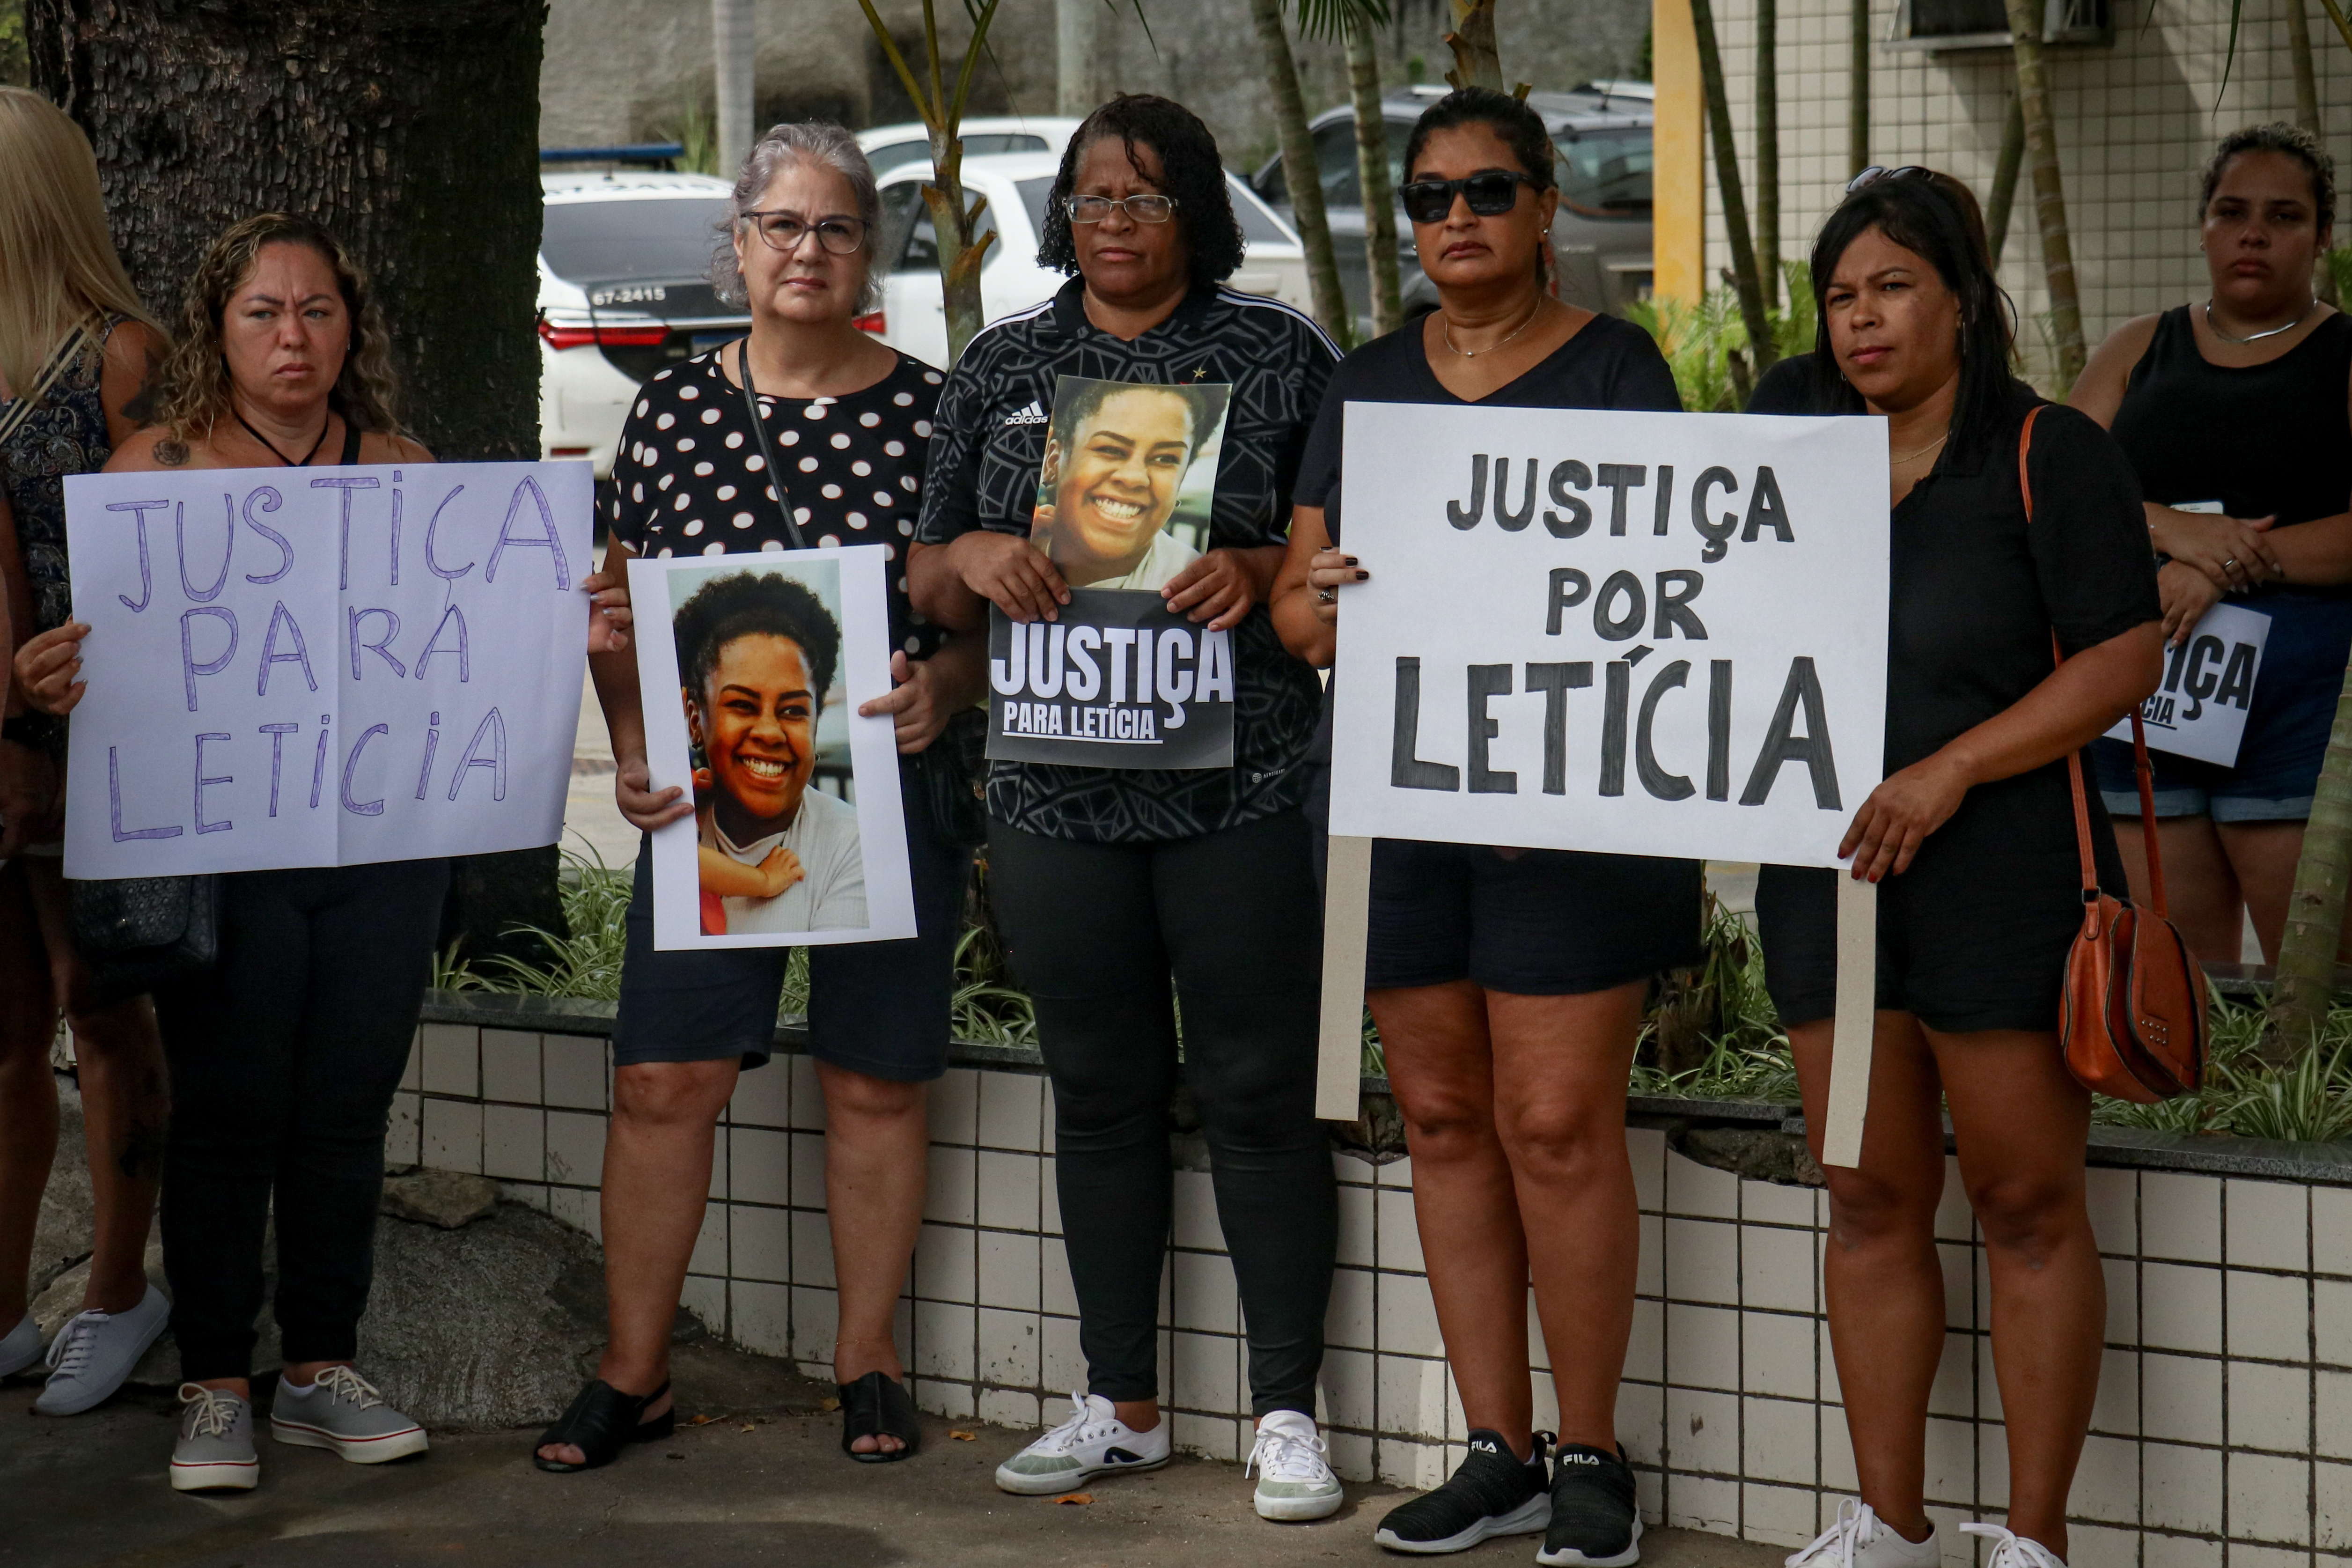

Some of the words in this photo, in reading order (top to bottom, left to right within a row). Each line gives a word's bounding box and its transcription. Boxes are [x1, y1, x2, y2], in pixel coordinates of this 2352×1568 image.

[592, 287, 666, 306] 67-2415
[1005, 415, 1048, 426] adidas
[1446, 453, 1796, 565] JUSTIÇA
[1545, 567, 1709, 641] POR
[180, 600, 469, 712] PARA
[990, 621, 1235, 729] JUSTIÇA
[2167, 634, 2257, 721] IÇA
[1003, 701, 1063, 735] PARA
[1070, 701, 1156, 739] LETÍCIA
[1390, 644, 1844, 812] LETÍCIA
[2141, 695, 2176, 725] CIA
[1470, 1440, 1497, 1454] FILA
[1563, 1453, 1600, 1466] FILA
